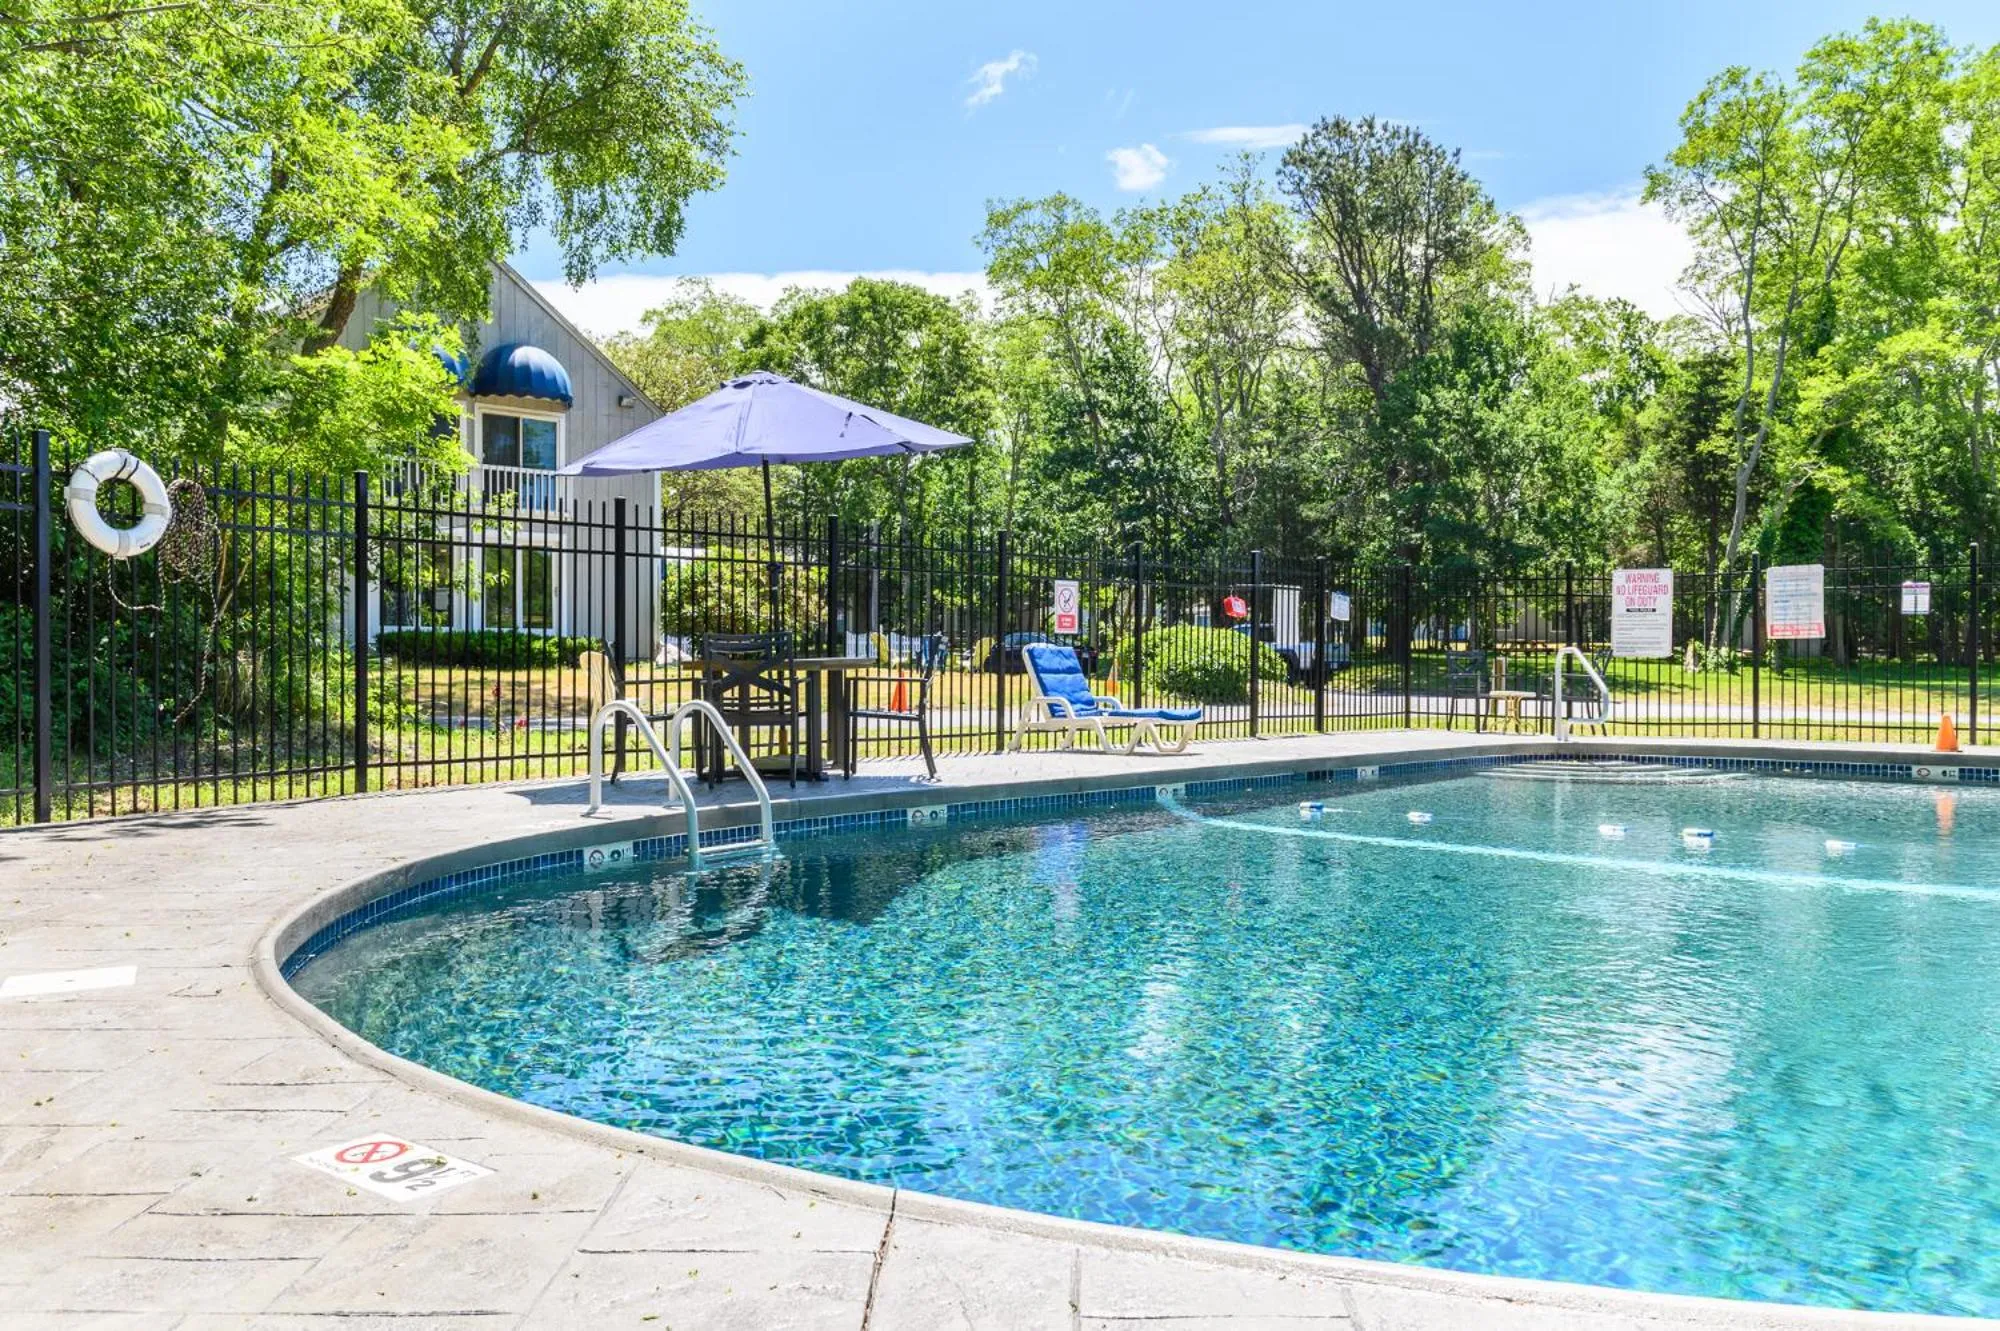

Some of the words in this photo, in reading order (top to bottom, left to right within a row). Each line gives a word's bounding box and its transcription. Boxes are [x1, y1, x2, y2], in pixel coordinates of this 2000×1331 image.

[1625, 572, 1660, 584] WARNING
[1616, 585, 1626, 596] NO
[1627, 584, 1669, 595] LIFEGUARD
[1625, 596, 1636, 607] ON
[1638, 596, 1657, 607] DUTY
